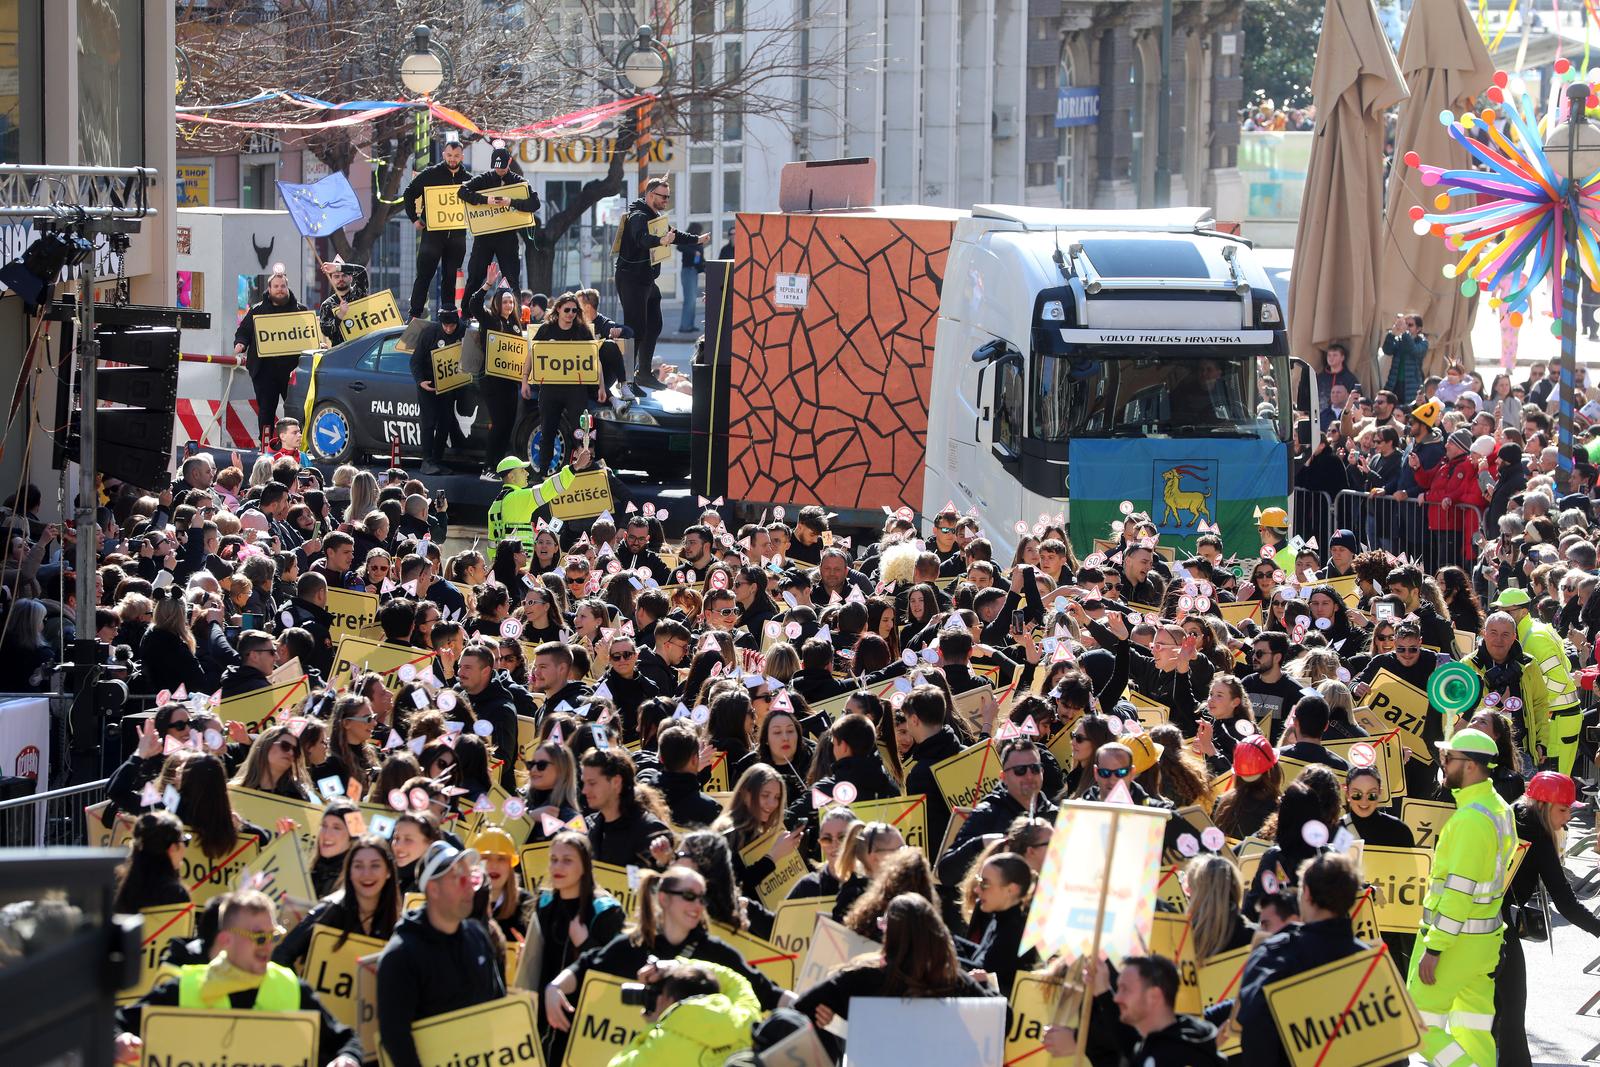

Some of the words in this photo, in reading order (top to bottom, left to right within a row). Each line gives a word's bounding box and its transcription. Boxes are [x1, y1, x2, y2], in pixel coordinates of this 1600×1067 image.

[1056, 95, 1099, 119] ADRIATIC
[343, 303, 397, 335] Pifari
[258, 325, 317, 343] Drndići
[1139, 335, 1182, 343] TRUCKS
[497, 339, 524, 355] Jakići
[537, 355, 594, 375] Topid
[371, 400, 394, 415] FALA
[396, 402, 420, 417] BOGU
[551, 487, 608, 505] Gračišće
[505, 623, 518, 635] 50
[1288, 986, 1402, 1053] Muntić
